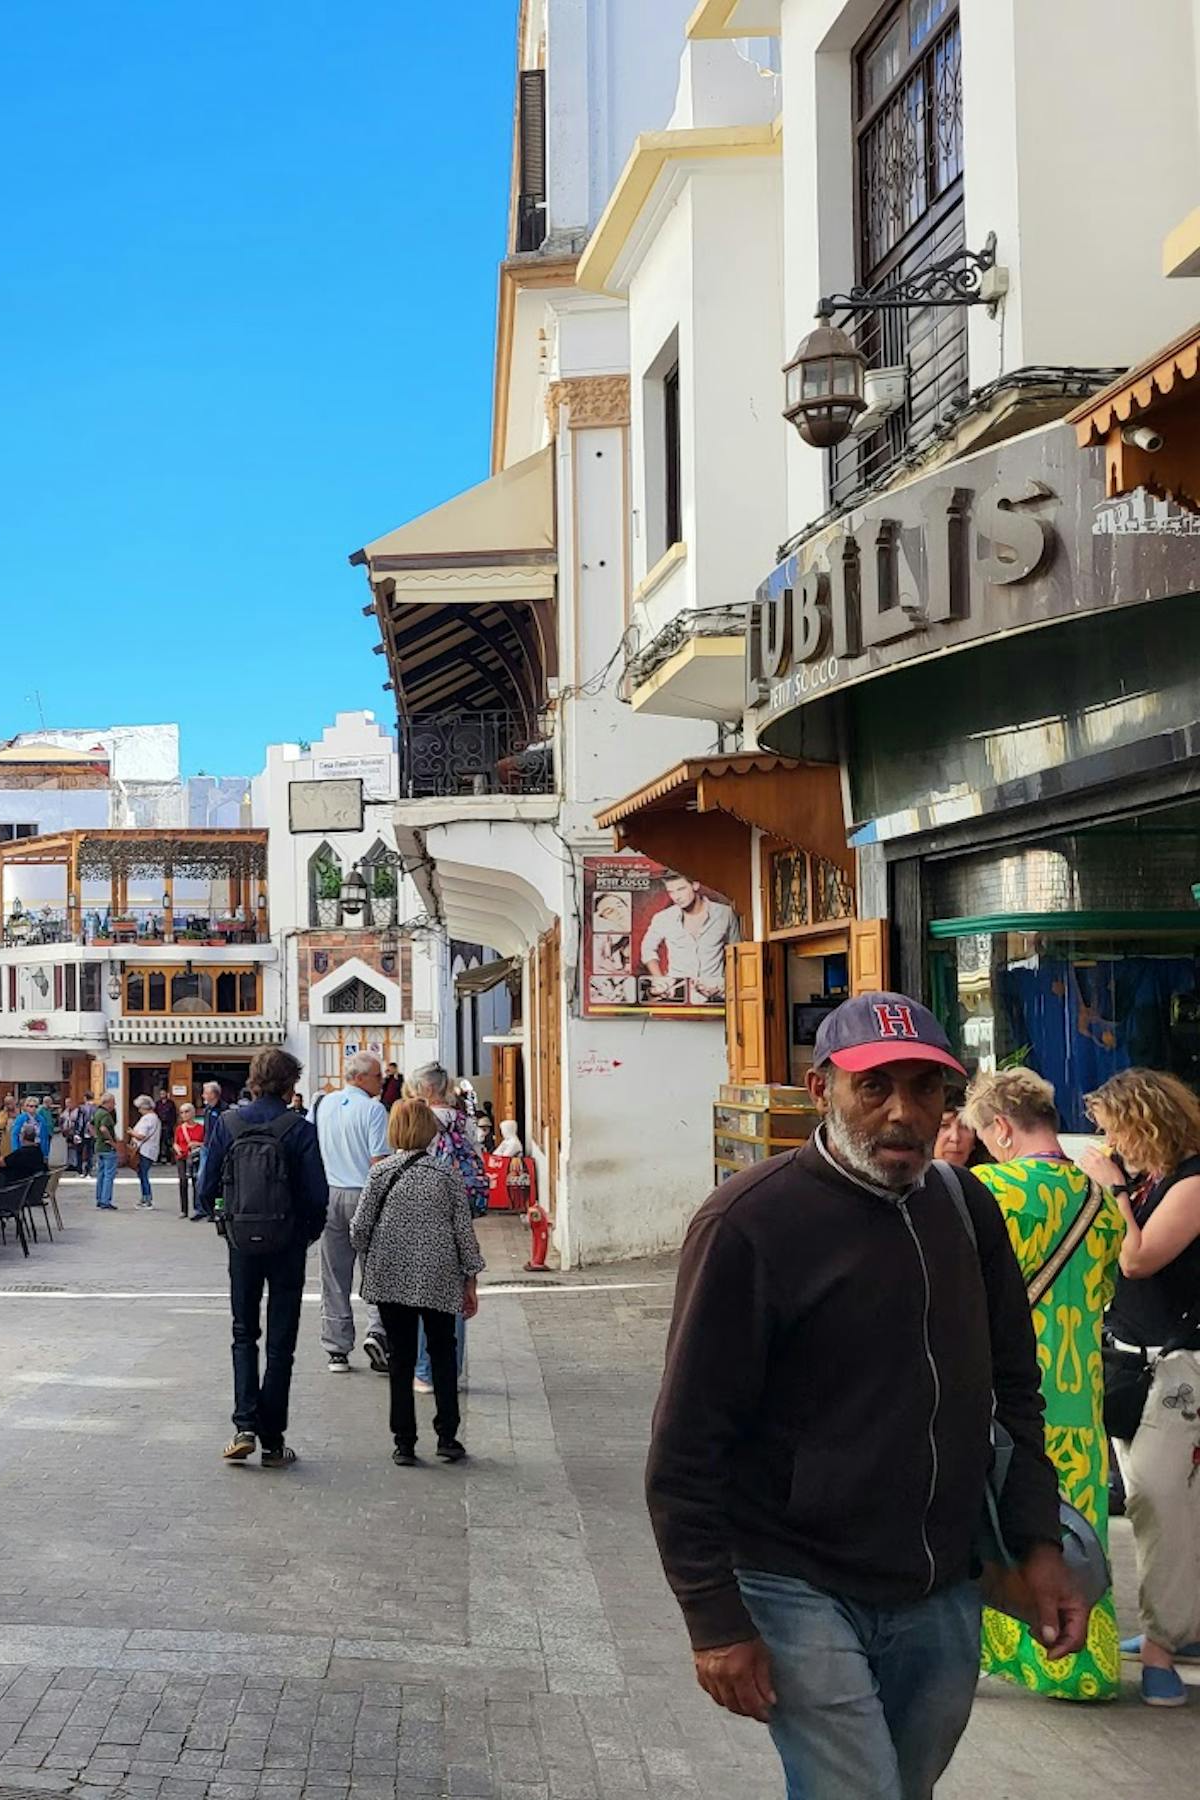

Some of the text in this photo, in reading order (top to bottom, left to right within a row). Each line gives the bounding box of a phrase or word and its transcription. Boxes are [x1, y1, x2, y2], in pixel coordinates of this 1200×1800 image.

[769, 656, 837, 708] PETIT SOCCO
[596, 878, 650, 886] PETIT SOCCO
[873, 1004, 918, 1038] H
